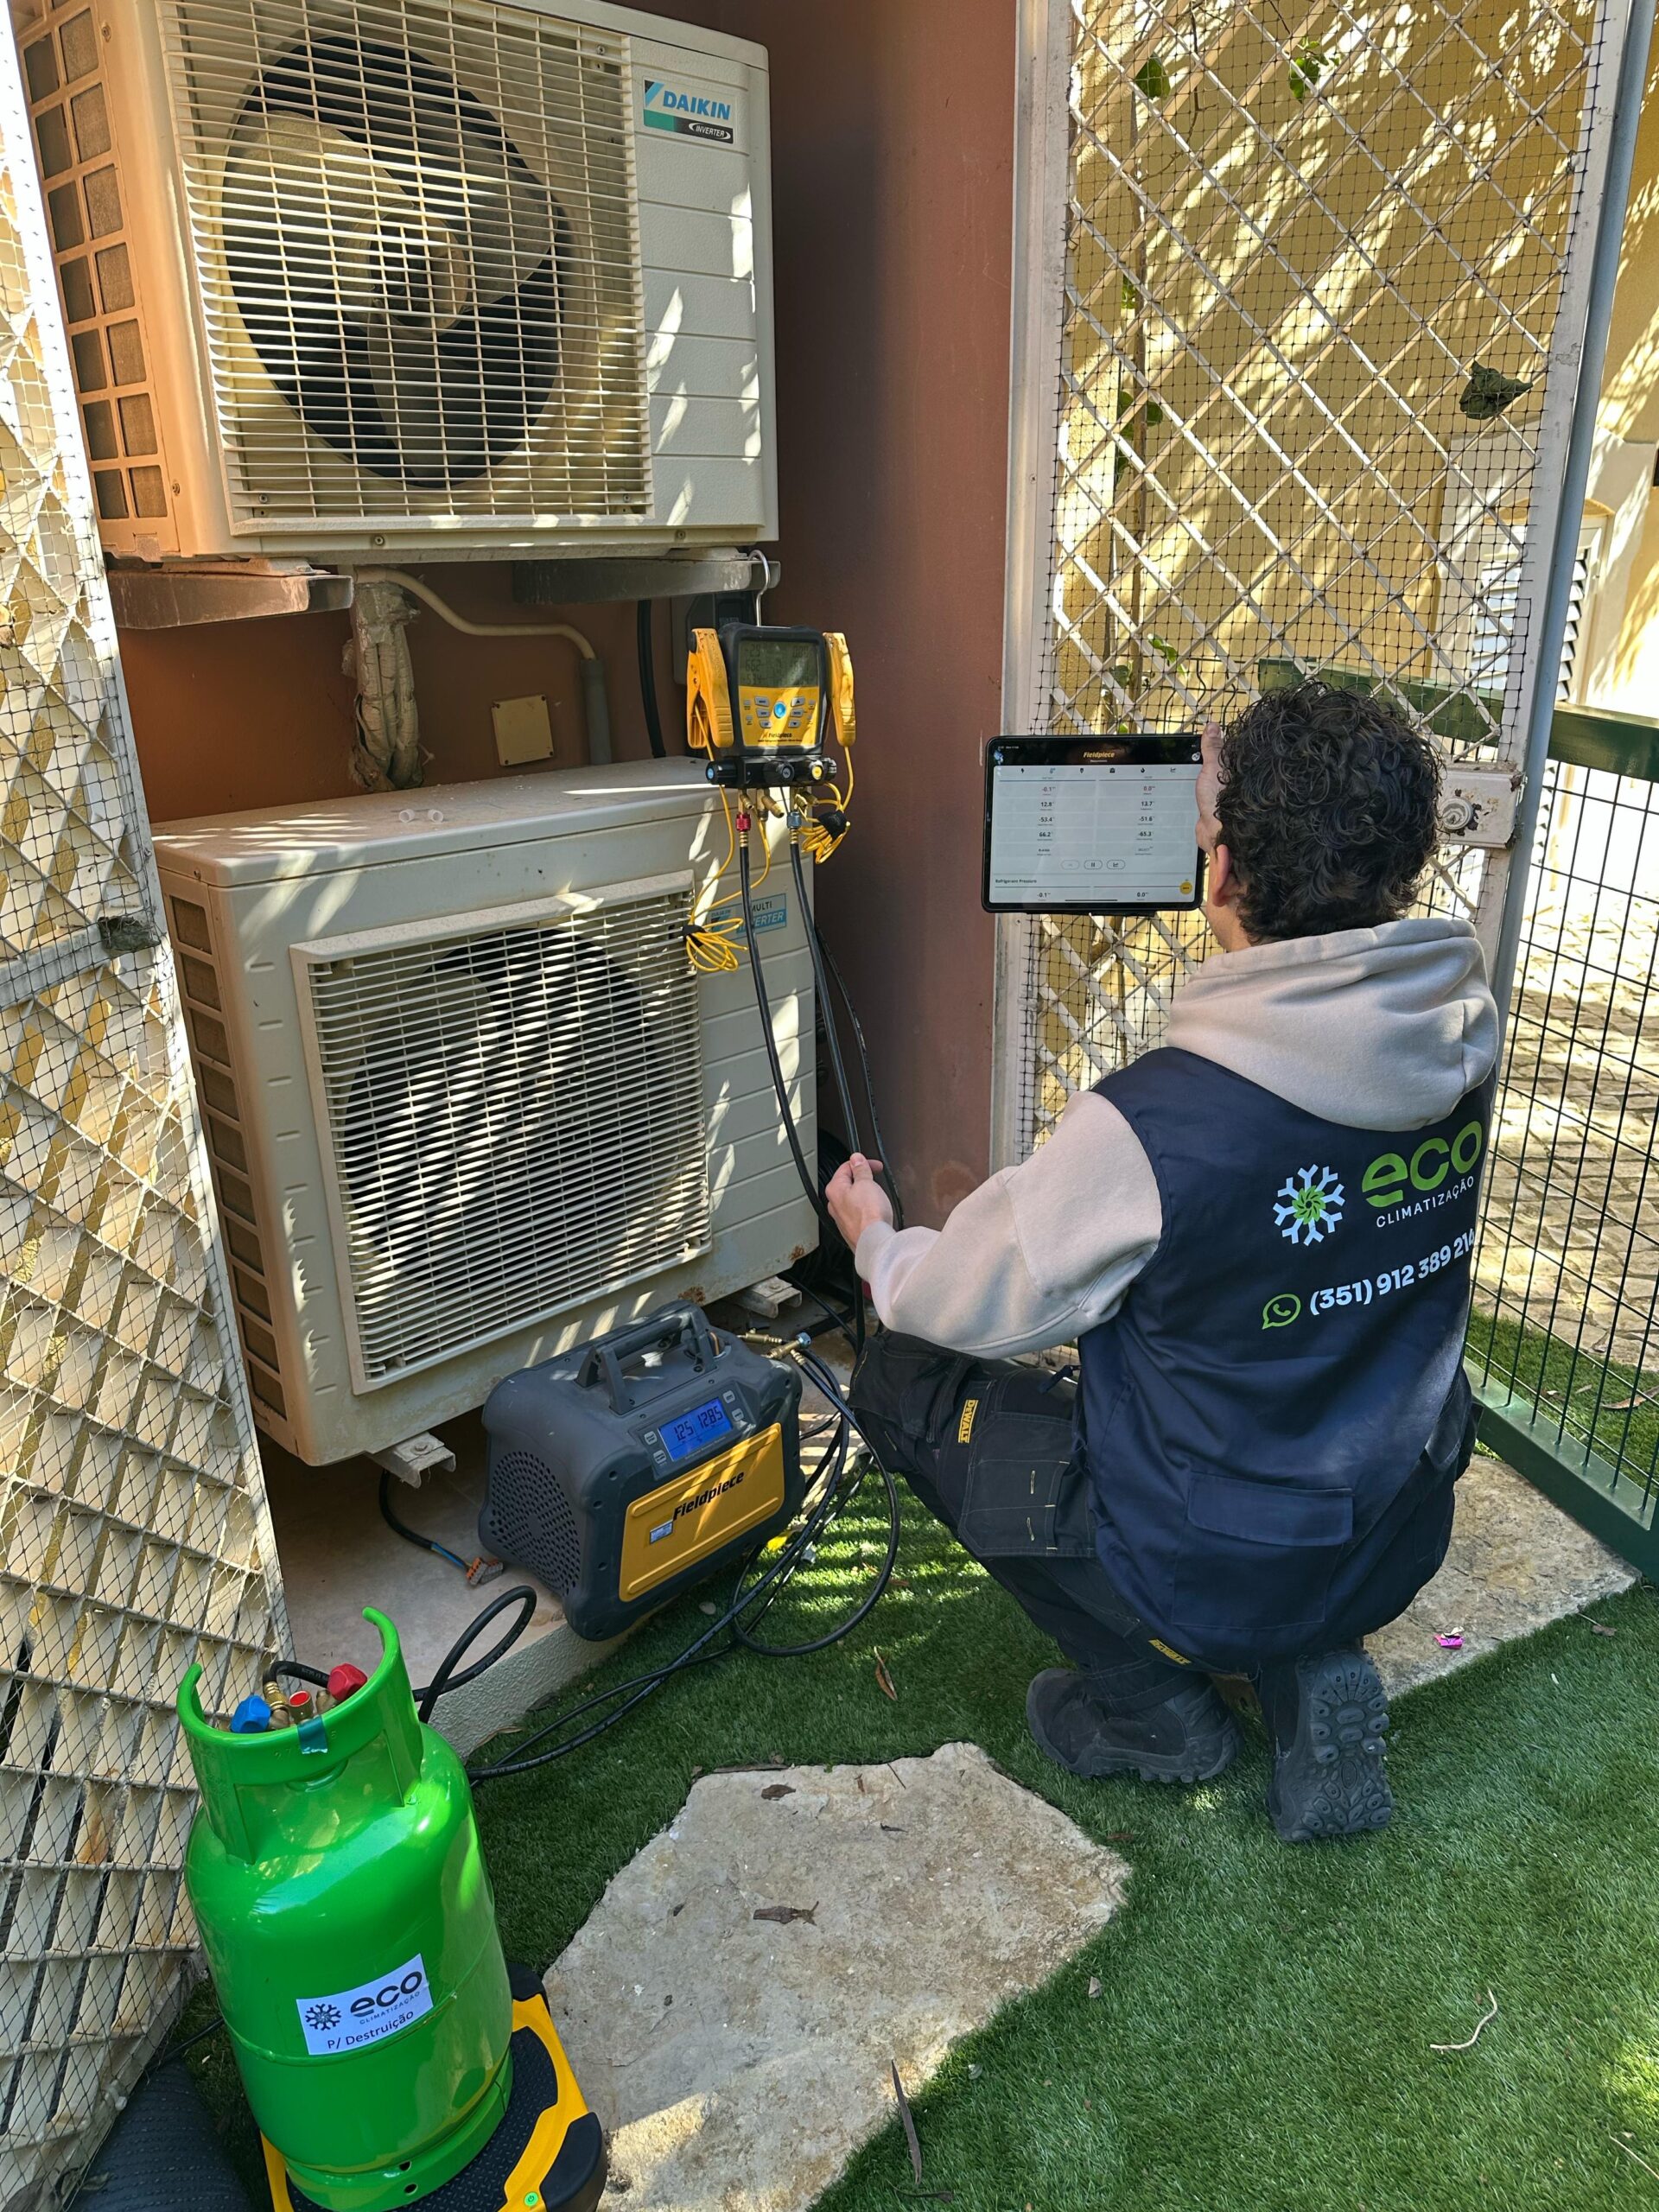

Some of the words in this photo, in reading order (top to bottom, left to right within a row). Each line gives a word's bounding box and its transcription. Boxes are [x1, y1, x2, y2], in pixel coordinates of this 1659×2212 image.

[663, 90, 731, 120] DAIKIN
[696, 124, 725, 137] INVERTER
[1361, 1121, 1483, 1208] eco
[1376, 1175, 1474, 1228] CLIMATIZAÇÃO
[1310, 1279, 1372, 1315] (351)
[1376, 1265, 1414, 1295] 912
[1419, 1246, 1452, 1279] 389
[1453, 1228, 1475, 1259] 214
[672, 1471, 744, 1521] Fieldpiece
[350, 1971, 423, 2018] eco
[359, 1991, 421, 2024] CLIMATIZAÇÃO
[327, 2037, 341, 2050] P/
[346, 2011, 414, 2045] Destruição
